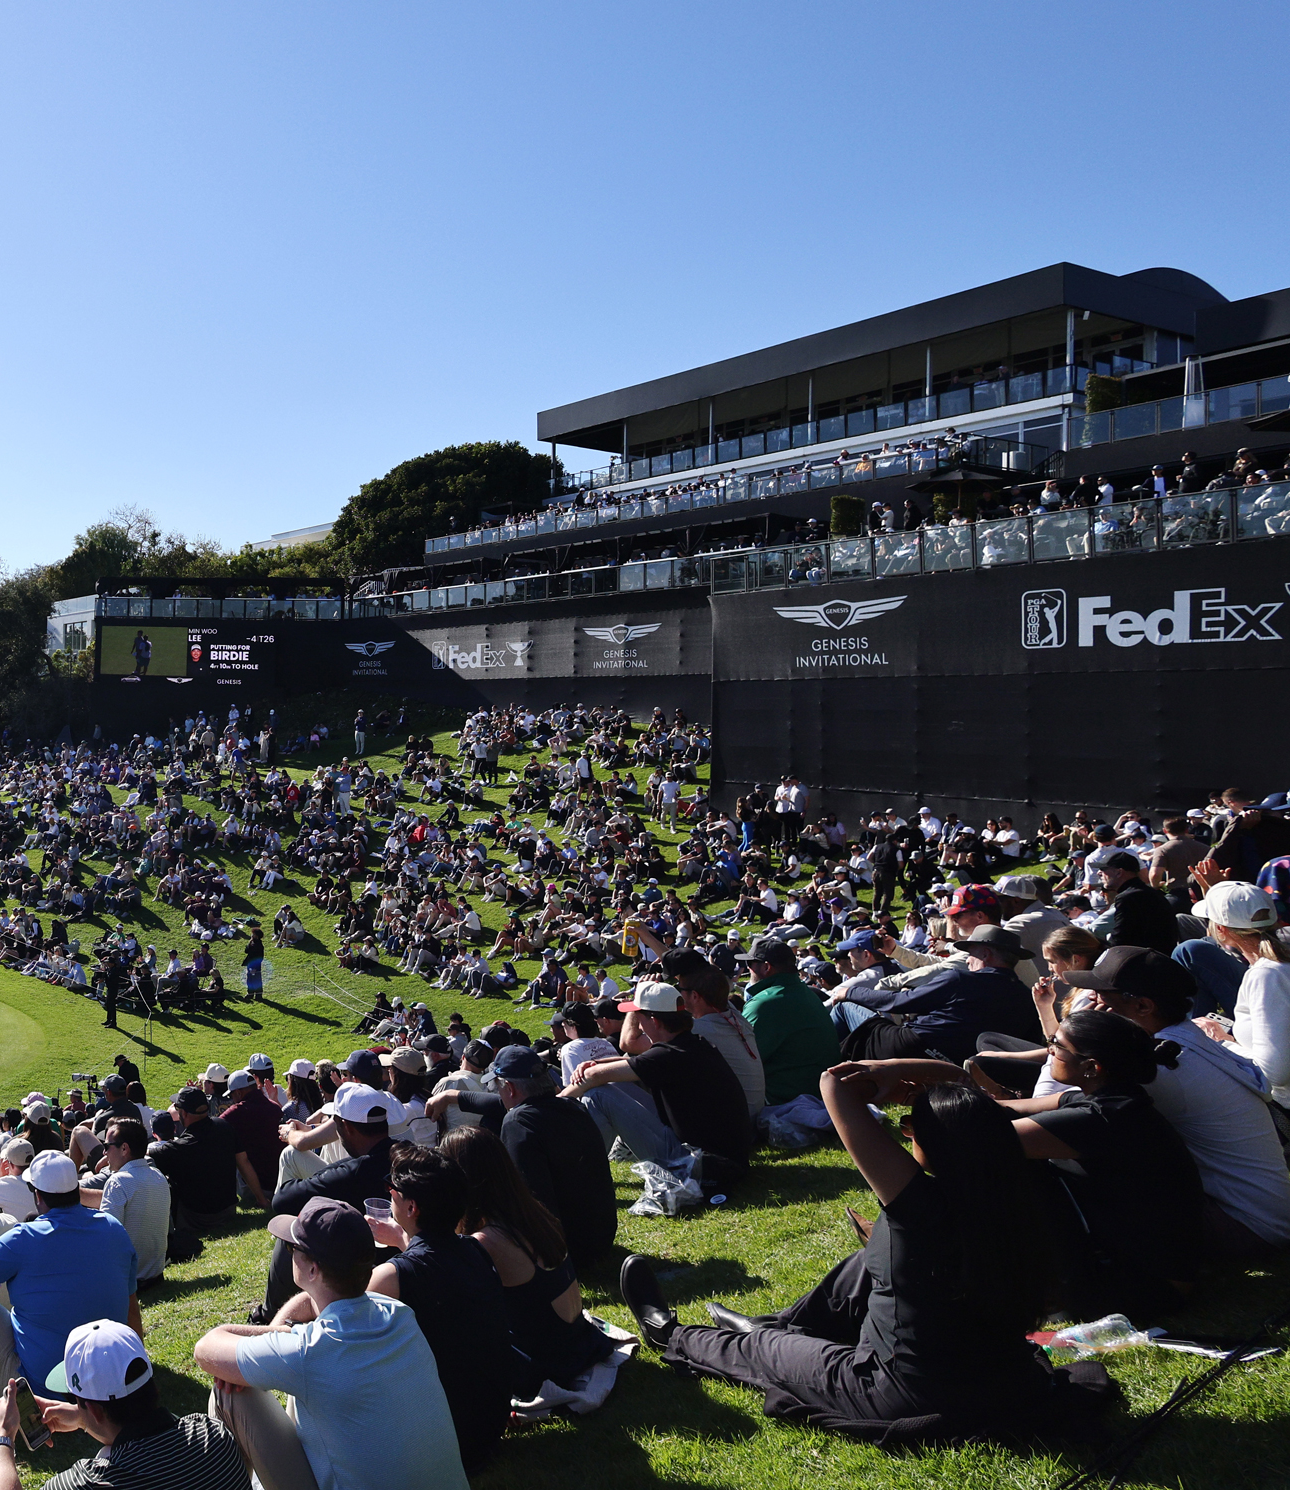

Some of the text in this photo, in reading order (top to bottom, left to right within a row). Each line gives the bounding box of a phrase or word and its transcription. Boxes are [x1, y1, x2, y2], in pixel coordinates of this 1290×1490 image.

[1027, 605, 1040, 644] TOUR
[1078, 588, 1284, 647] FedEx
[811, 636, 869, 652] GENESIS
[210, 650, 250, 661] BIRDIE
[448, 642, 506, 668] FedEx
[604, 649, 638, 658] GENESIS
[796, 652, 889, 668] INVITATIONAL
[593, 659, 648, 669] INVITATIONAL
